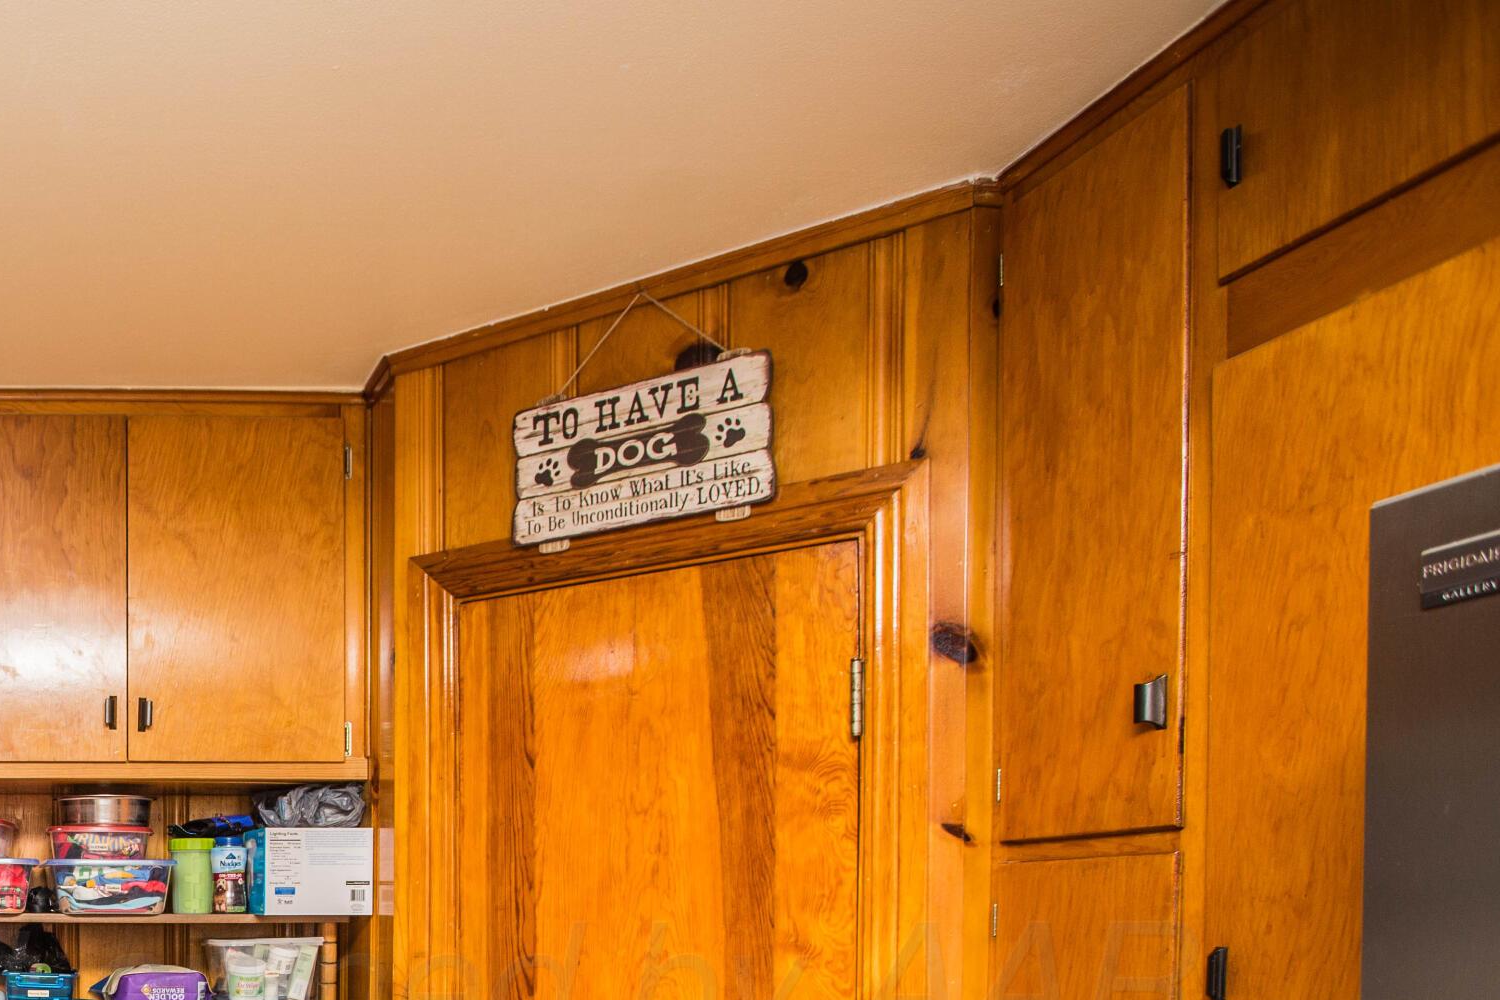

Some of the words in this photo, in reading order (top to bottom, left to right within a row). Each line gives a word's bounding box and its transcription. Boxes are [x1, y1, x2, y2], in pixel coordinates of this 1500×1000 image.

[533, 408, 579, 446] TO
[594, 376, 700, 433] HAVE
[716, 367, 744, 405] A
[594, 432, 678, 475] DOG
[525, 519, 541, 535] To
[548, 515, 566, 532] Be
[572, 492, 689, 527] Unconditionally
[697, 476, 765, 505] LOVED.
[532, 501, 545, 517] Is
[555, 495, 571, 512] To
[579, 488, 622, 508] Know
[630, 477, 671, 497] What
[681, 468, 704, 486] It's
[713, 460, 751, 481] Like
[1442, 580, 1498, 600] GALLERY
[147, 993, 185, 1000] GOLDEN
